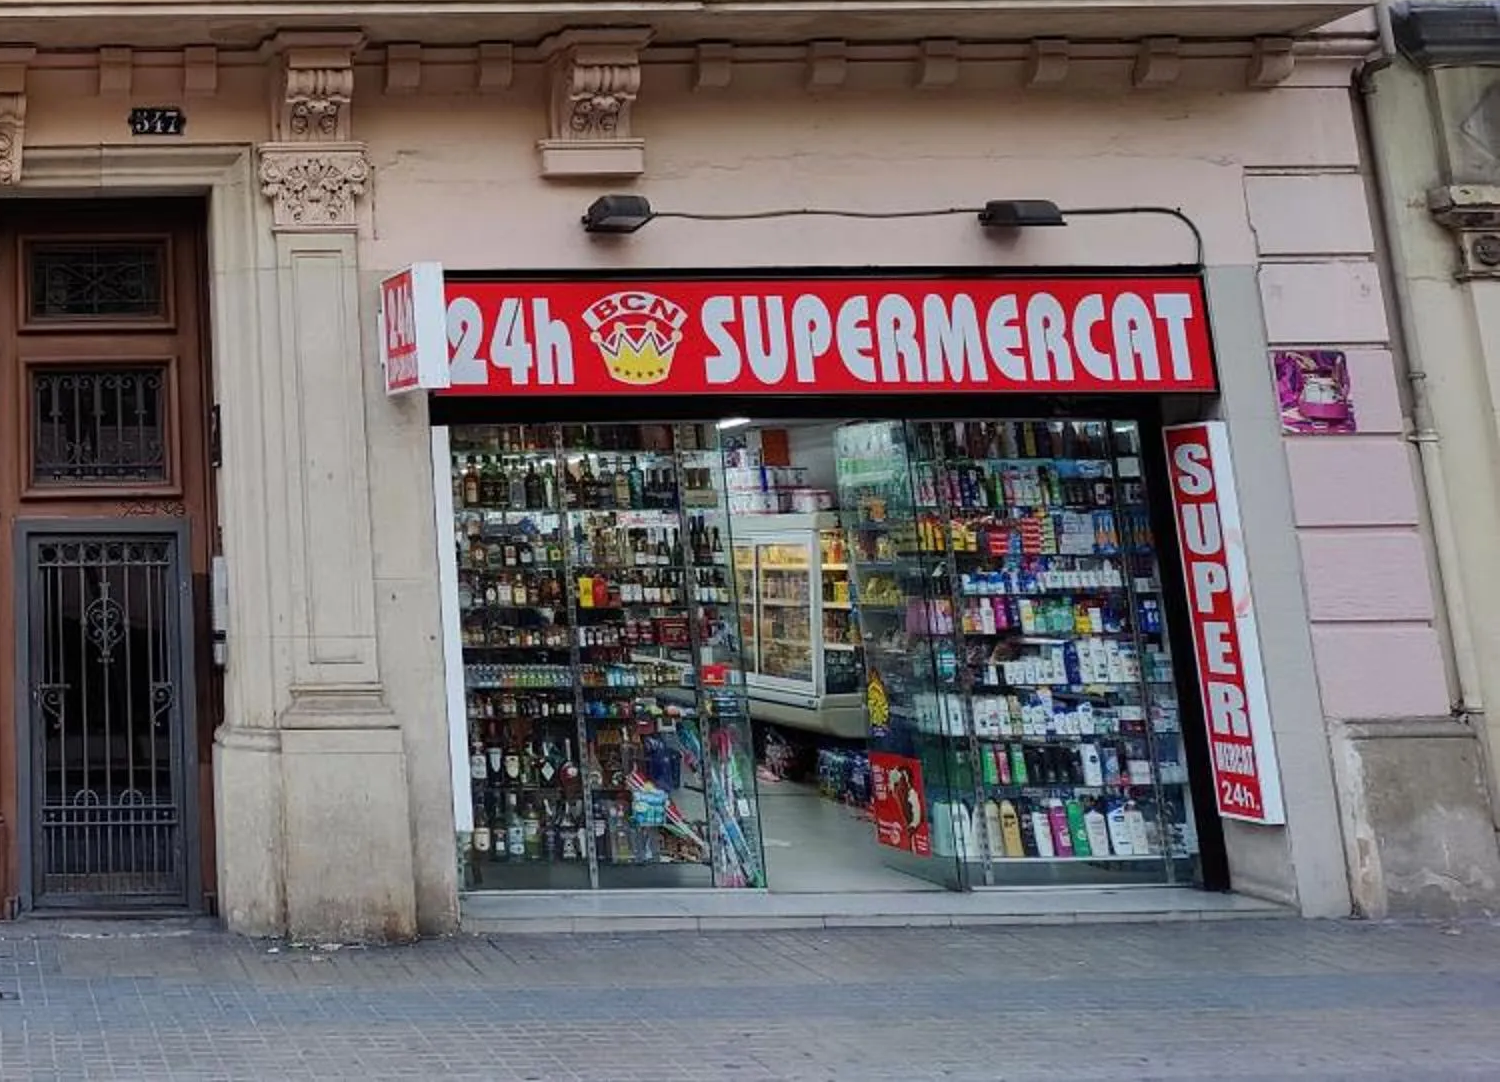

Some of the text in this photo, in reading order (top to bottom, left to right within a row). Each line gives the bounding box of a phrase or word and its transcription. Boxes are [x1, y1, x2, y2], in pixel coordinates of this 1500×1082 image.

[447, 296, 574, 384] 24h
[592, 294, 679, 321] BCN
[702, 291, 1192, 382] SUPERMERCAT
[1175, 443, 1251, 737] SUPER
